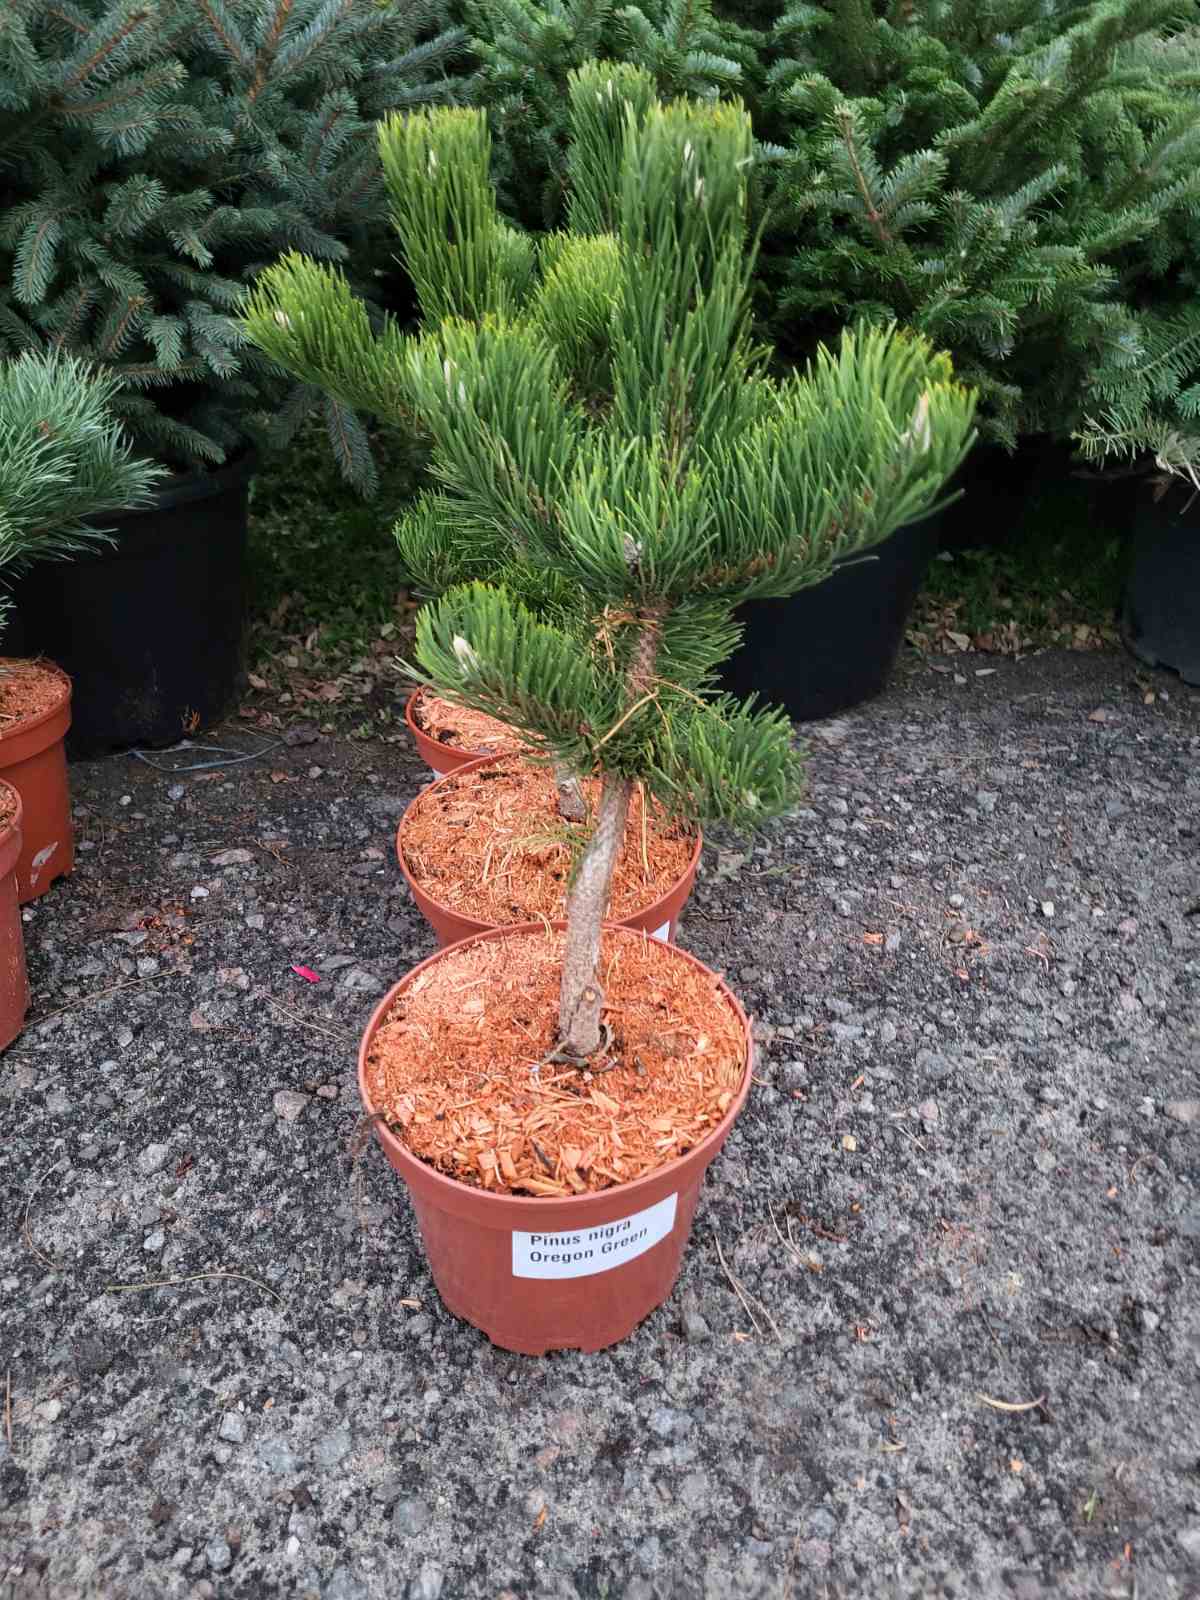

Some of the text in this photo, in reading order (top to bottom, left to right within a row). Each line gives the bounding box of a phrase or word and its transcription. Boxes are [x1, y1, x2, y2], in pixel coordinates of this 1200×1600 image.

[529, 1227, 648, 1264] Oregon Green
[530, 1219, 631, 1246] Pinus nigra
